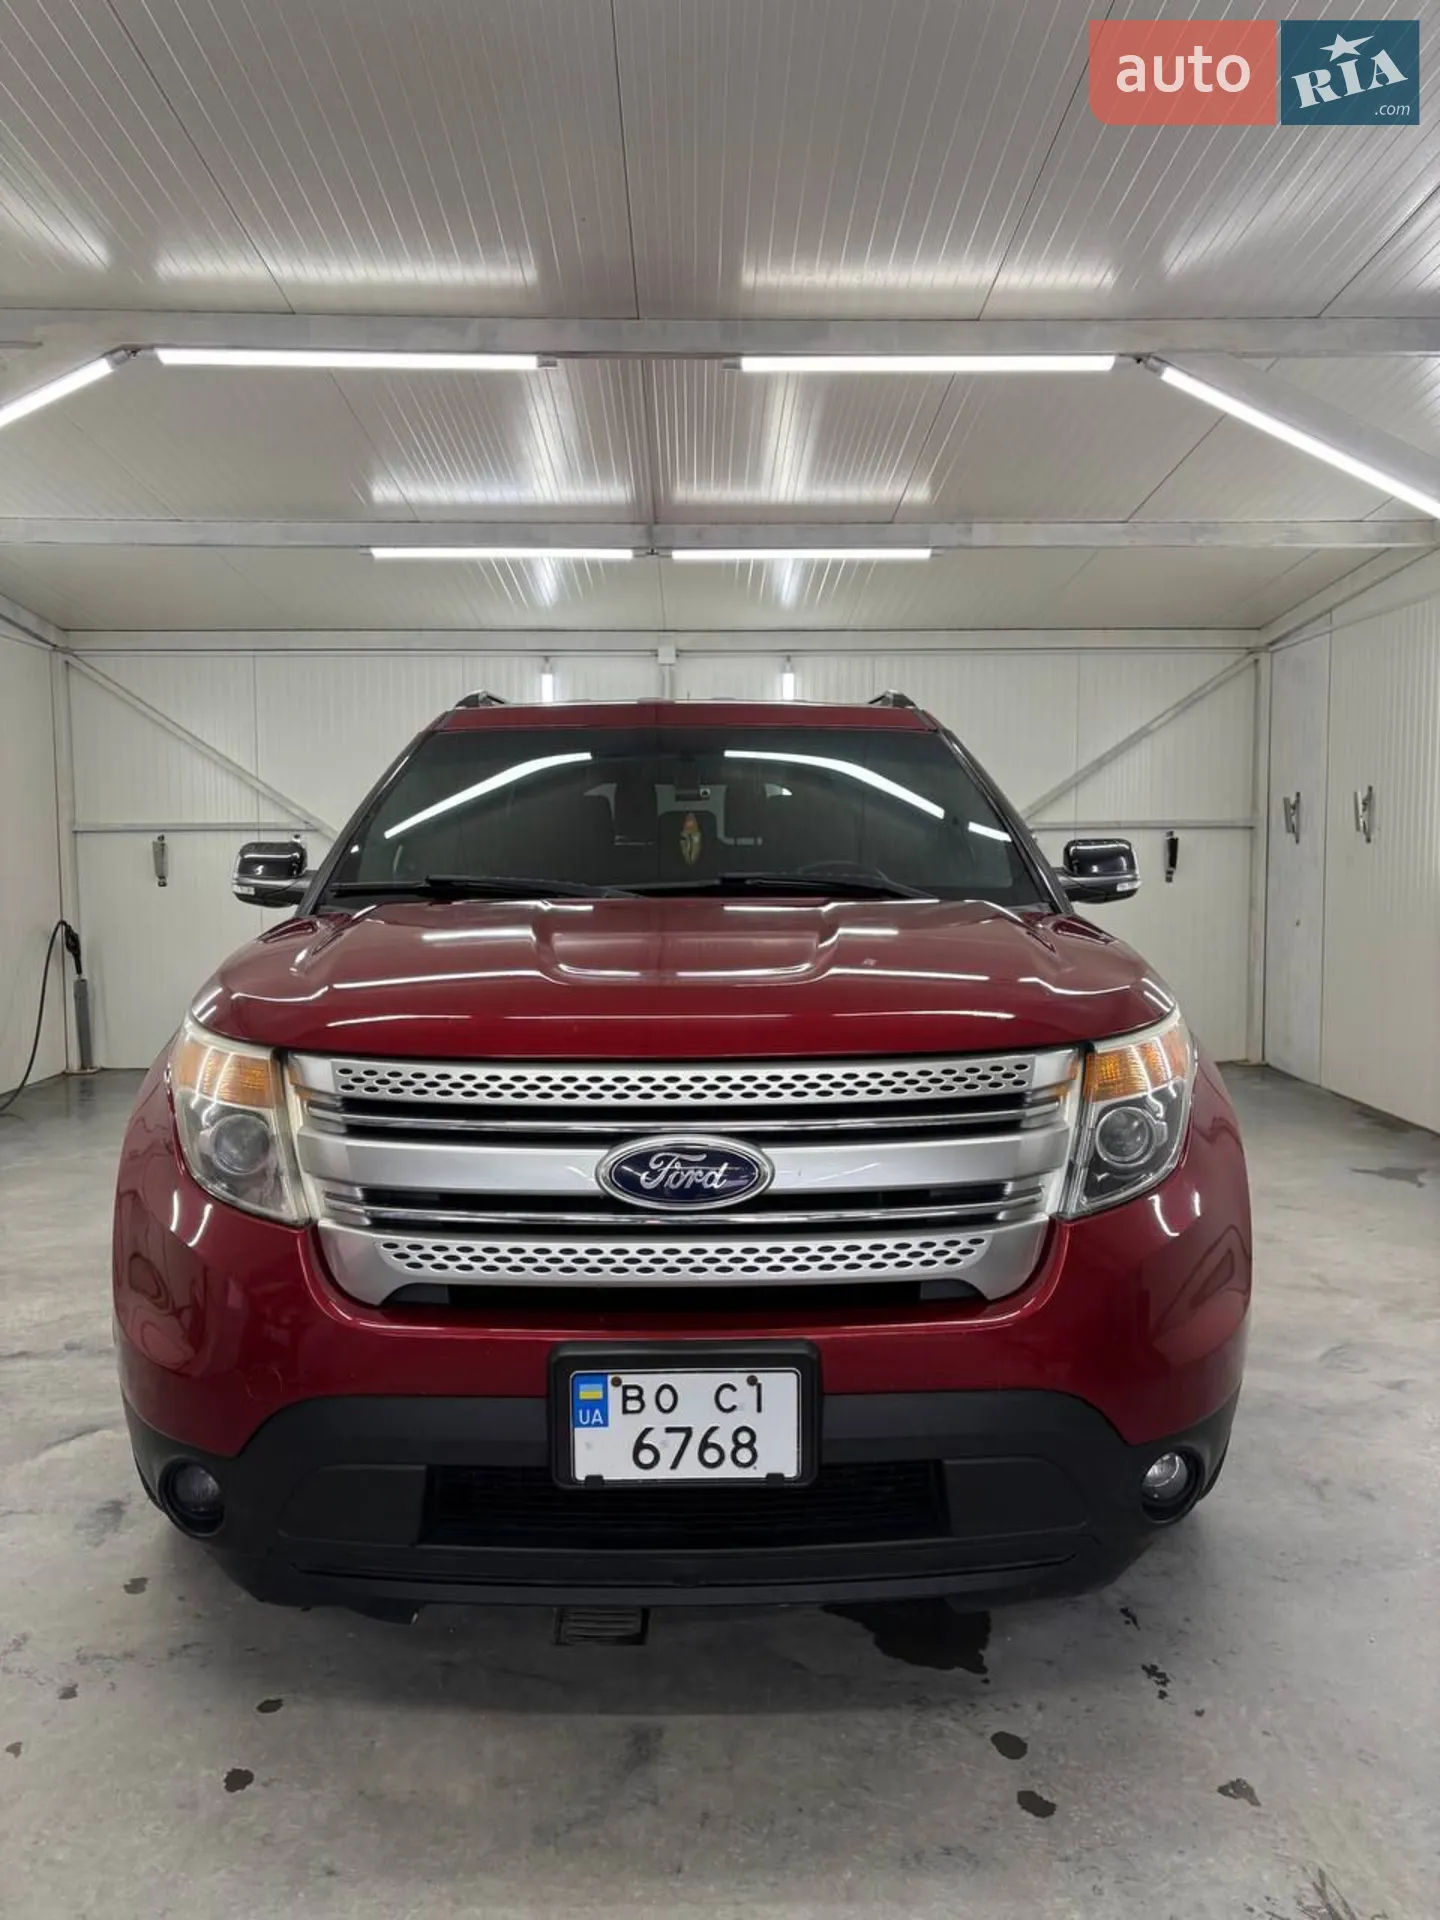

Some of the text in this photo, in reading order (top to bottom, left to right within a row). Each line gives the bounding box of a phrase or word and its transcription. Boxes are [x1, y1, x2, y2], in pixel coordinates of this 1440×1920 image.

[639, 1152, 729, 1189] Ford
[622, 1384, 679, 1414] BO
[579, 1409, 604, 1425] UA
[632, 1426, 758, 1470] 6768
